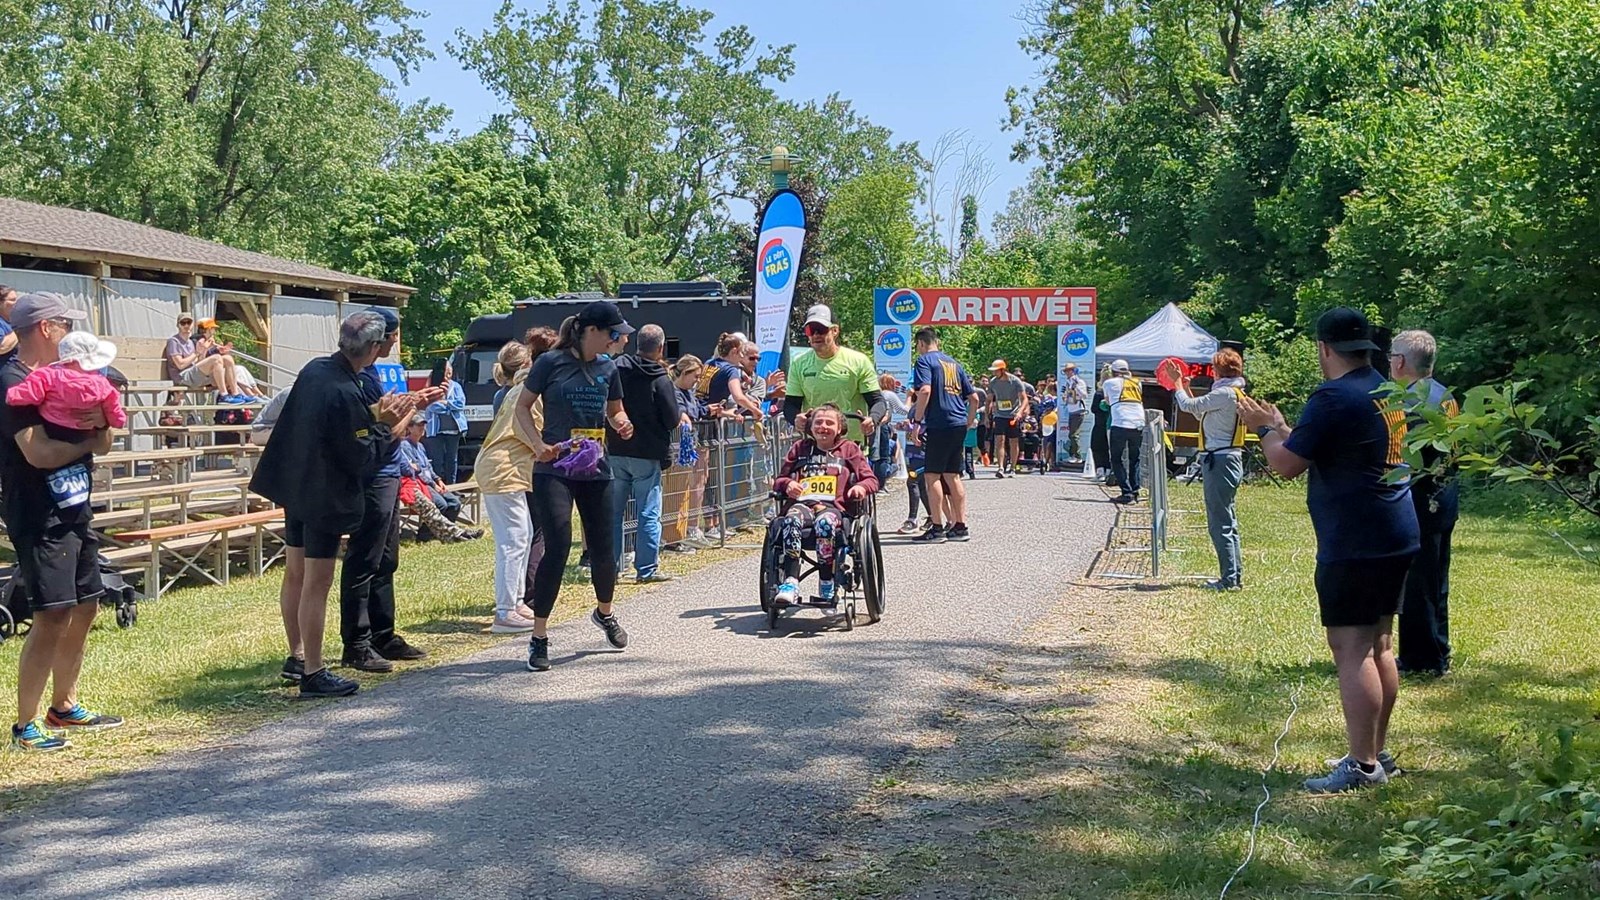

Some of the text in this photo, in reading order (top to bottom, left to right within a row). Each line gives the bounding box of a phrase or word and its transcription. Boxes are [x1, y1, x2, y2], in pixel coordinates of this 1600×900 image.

[765, 257, 790, 278] FRAS
[895, 304, 917, 314] FRAS
[931, 289, 1094, 322] ARRIVÉE
[883, 342, 903, 351] FRAS
[1067, 341, 1088, 351] FRAS
[811, 482, 833, 493] 904
